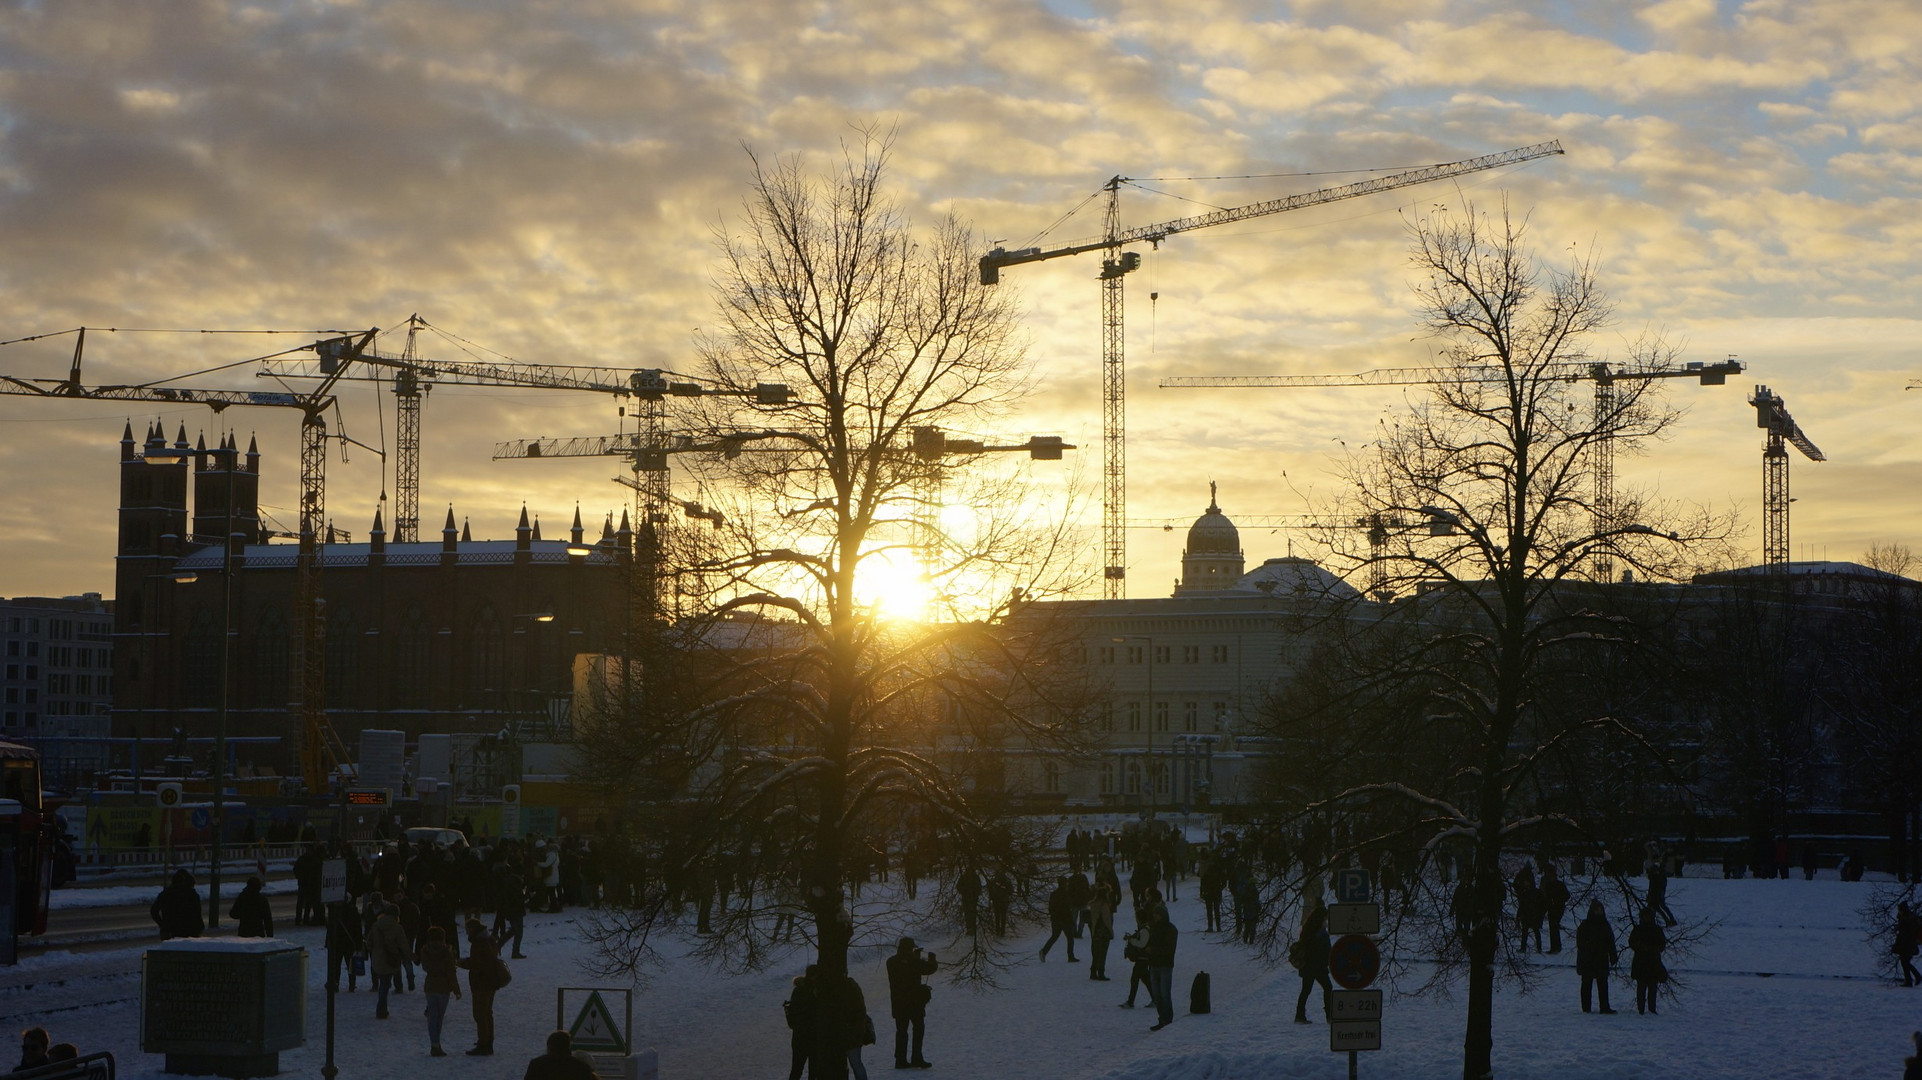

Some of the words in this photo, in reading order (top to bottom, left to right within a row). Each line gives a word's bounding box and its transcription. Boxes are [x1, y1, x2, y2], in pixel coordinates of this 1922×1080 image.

[1346, 873, 1363, 898] P
[1337, 1000, 1344, 1011] 8
[1358, 999, 1377, 1011] 22h
